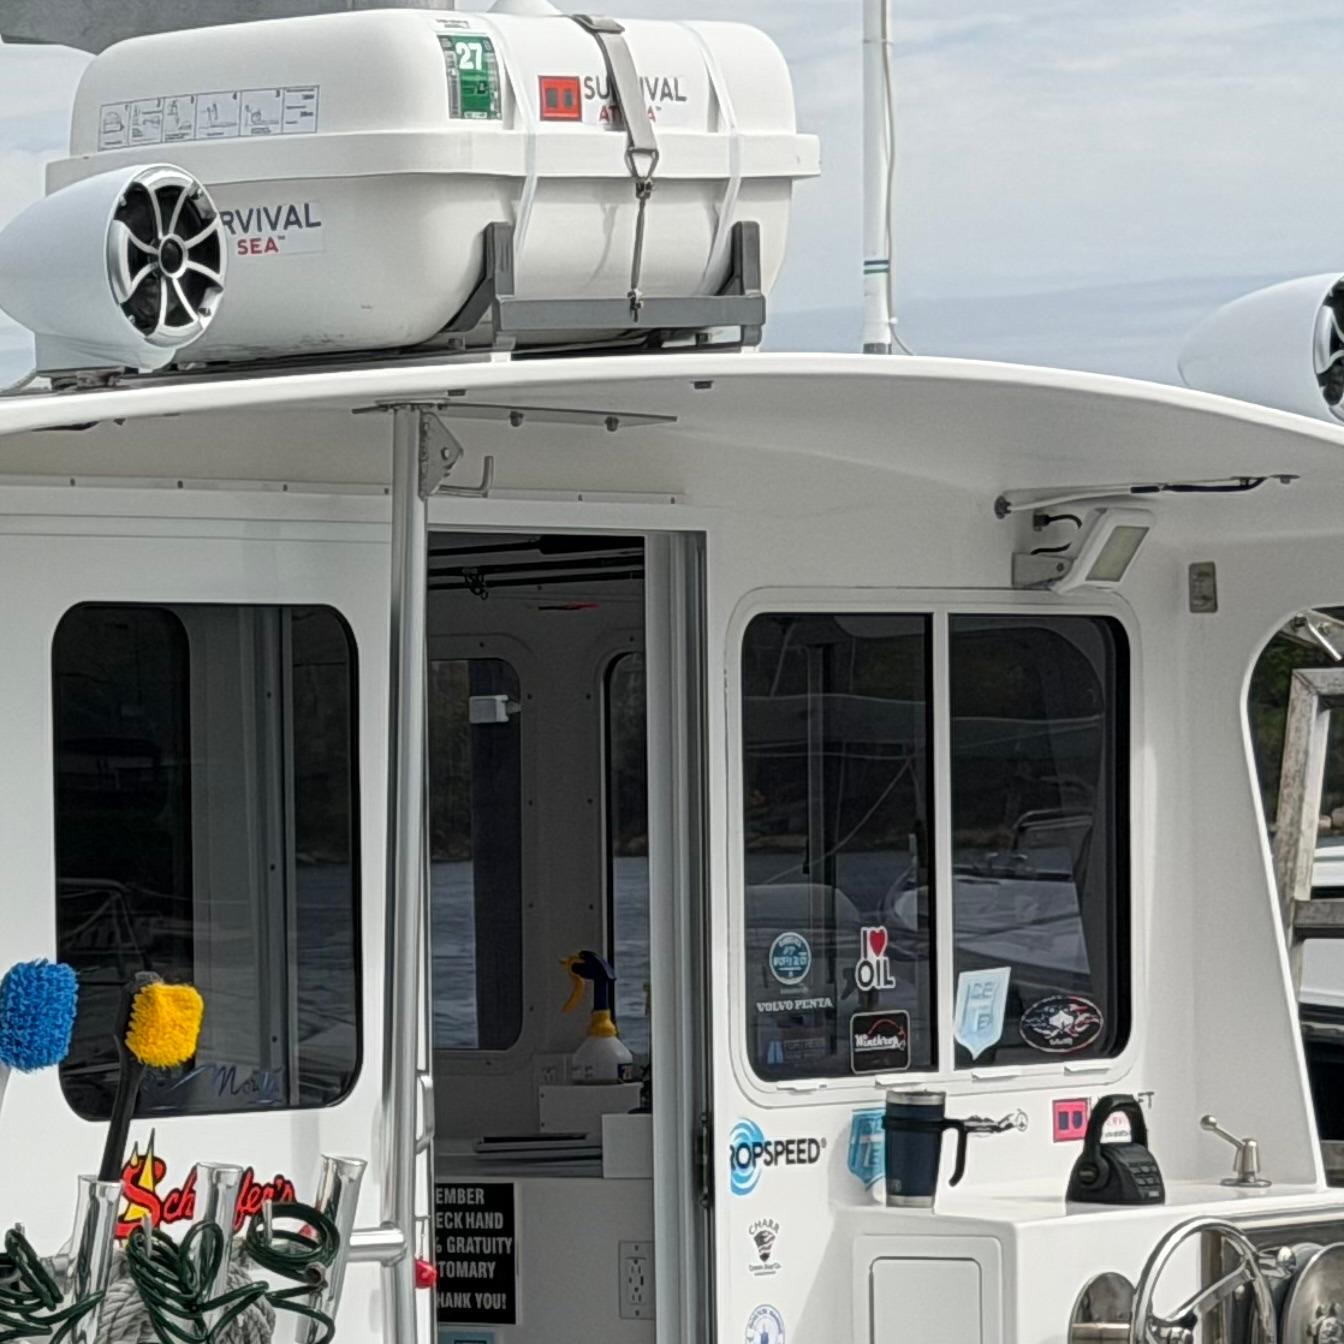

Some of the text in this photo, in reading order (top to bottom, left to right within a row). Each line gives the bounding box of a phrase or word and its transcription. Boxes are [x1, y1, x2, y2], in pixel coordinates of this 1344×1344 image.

[455, 41, 482, 70] 27
[584, 76, 687, 102] SUIVAL
[220, 202, 322, 235] RVIVAL
[857, 956, 896, 990] OIL
[756, 997, 834, 1012] VOLVO PENTA
[730, 1138, 820, 1170] OPSPEED
[114, 1155, 297, 1240] Schfer's
[436, 1187, 485, 1205] EMBER
[436, 1211, 504, 1229] ECK HAND
[446, 1236, 513, 1254] GRATUITY
[439, 1261, 496, 1278] TOMARY
[437, 1292, 507, 1309] HANK YOU!
